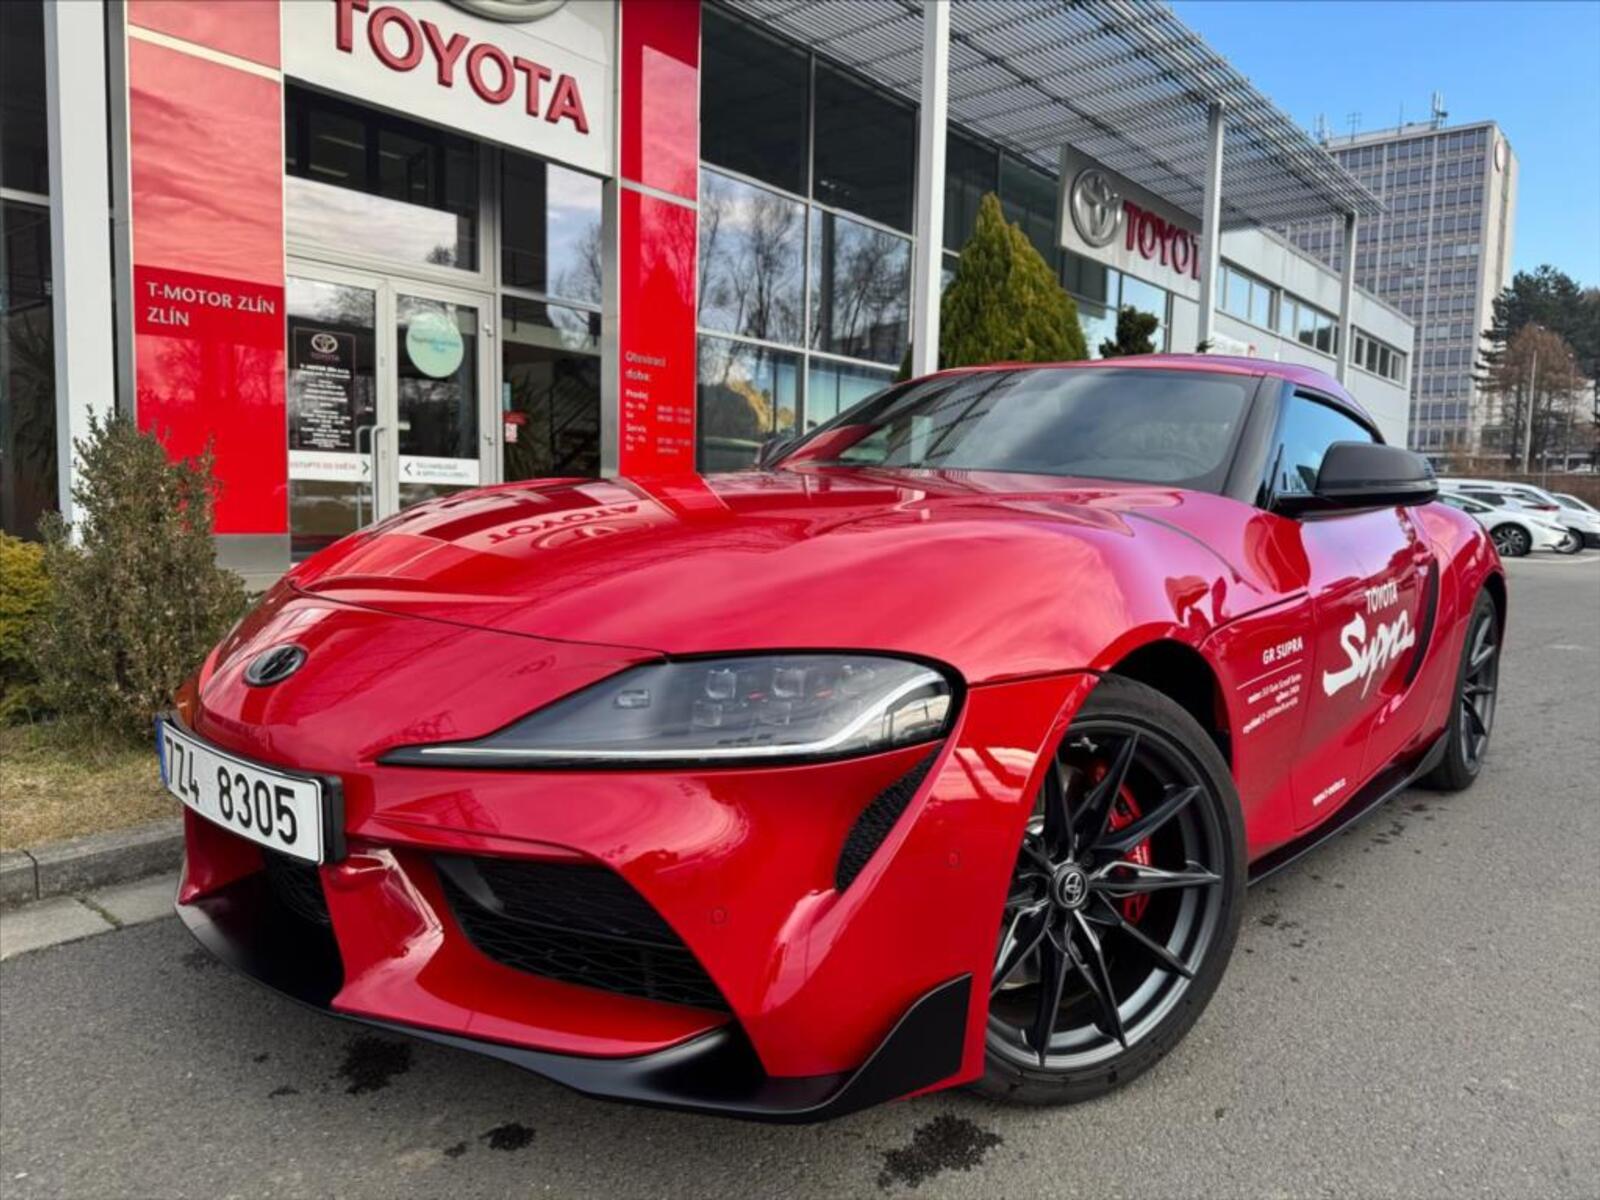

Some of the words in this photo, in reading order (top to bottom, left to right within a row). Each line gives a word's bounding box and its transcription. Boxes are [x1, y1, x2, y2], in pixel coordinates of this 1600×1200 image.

[334, 0, 589, 134] TOYOTA
[1123, 199, 1201, 280] TOYOT
[146, 281, 233, 309] T-MOTOR
[237, 294, 275, 315] ZLÍN
[147, 306, 190, 327] ZLÍN
[1365, 581, 1398, 613] TOYOTA
[1262, 648, 1275, 665] GR
[1276, 636, 1304, 660] SUPRA
[1323, 610, 1415, 700] Supra
[165, 735, 200, 804] 7Z4
[217, 765, 297, 845] 8305
